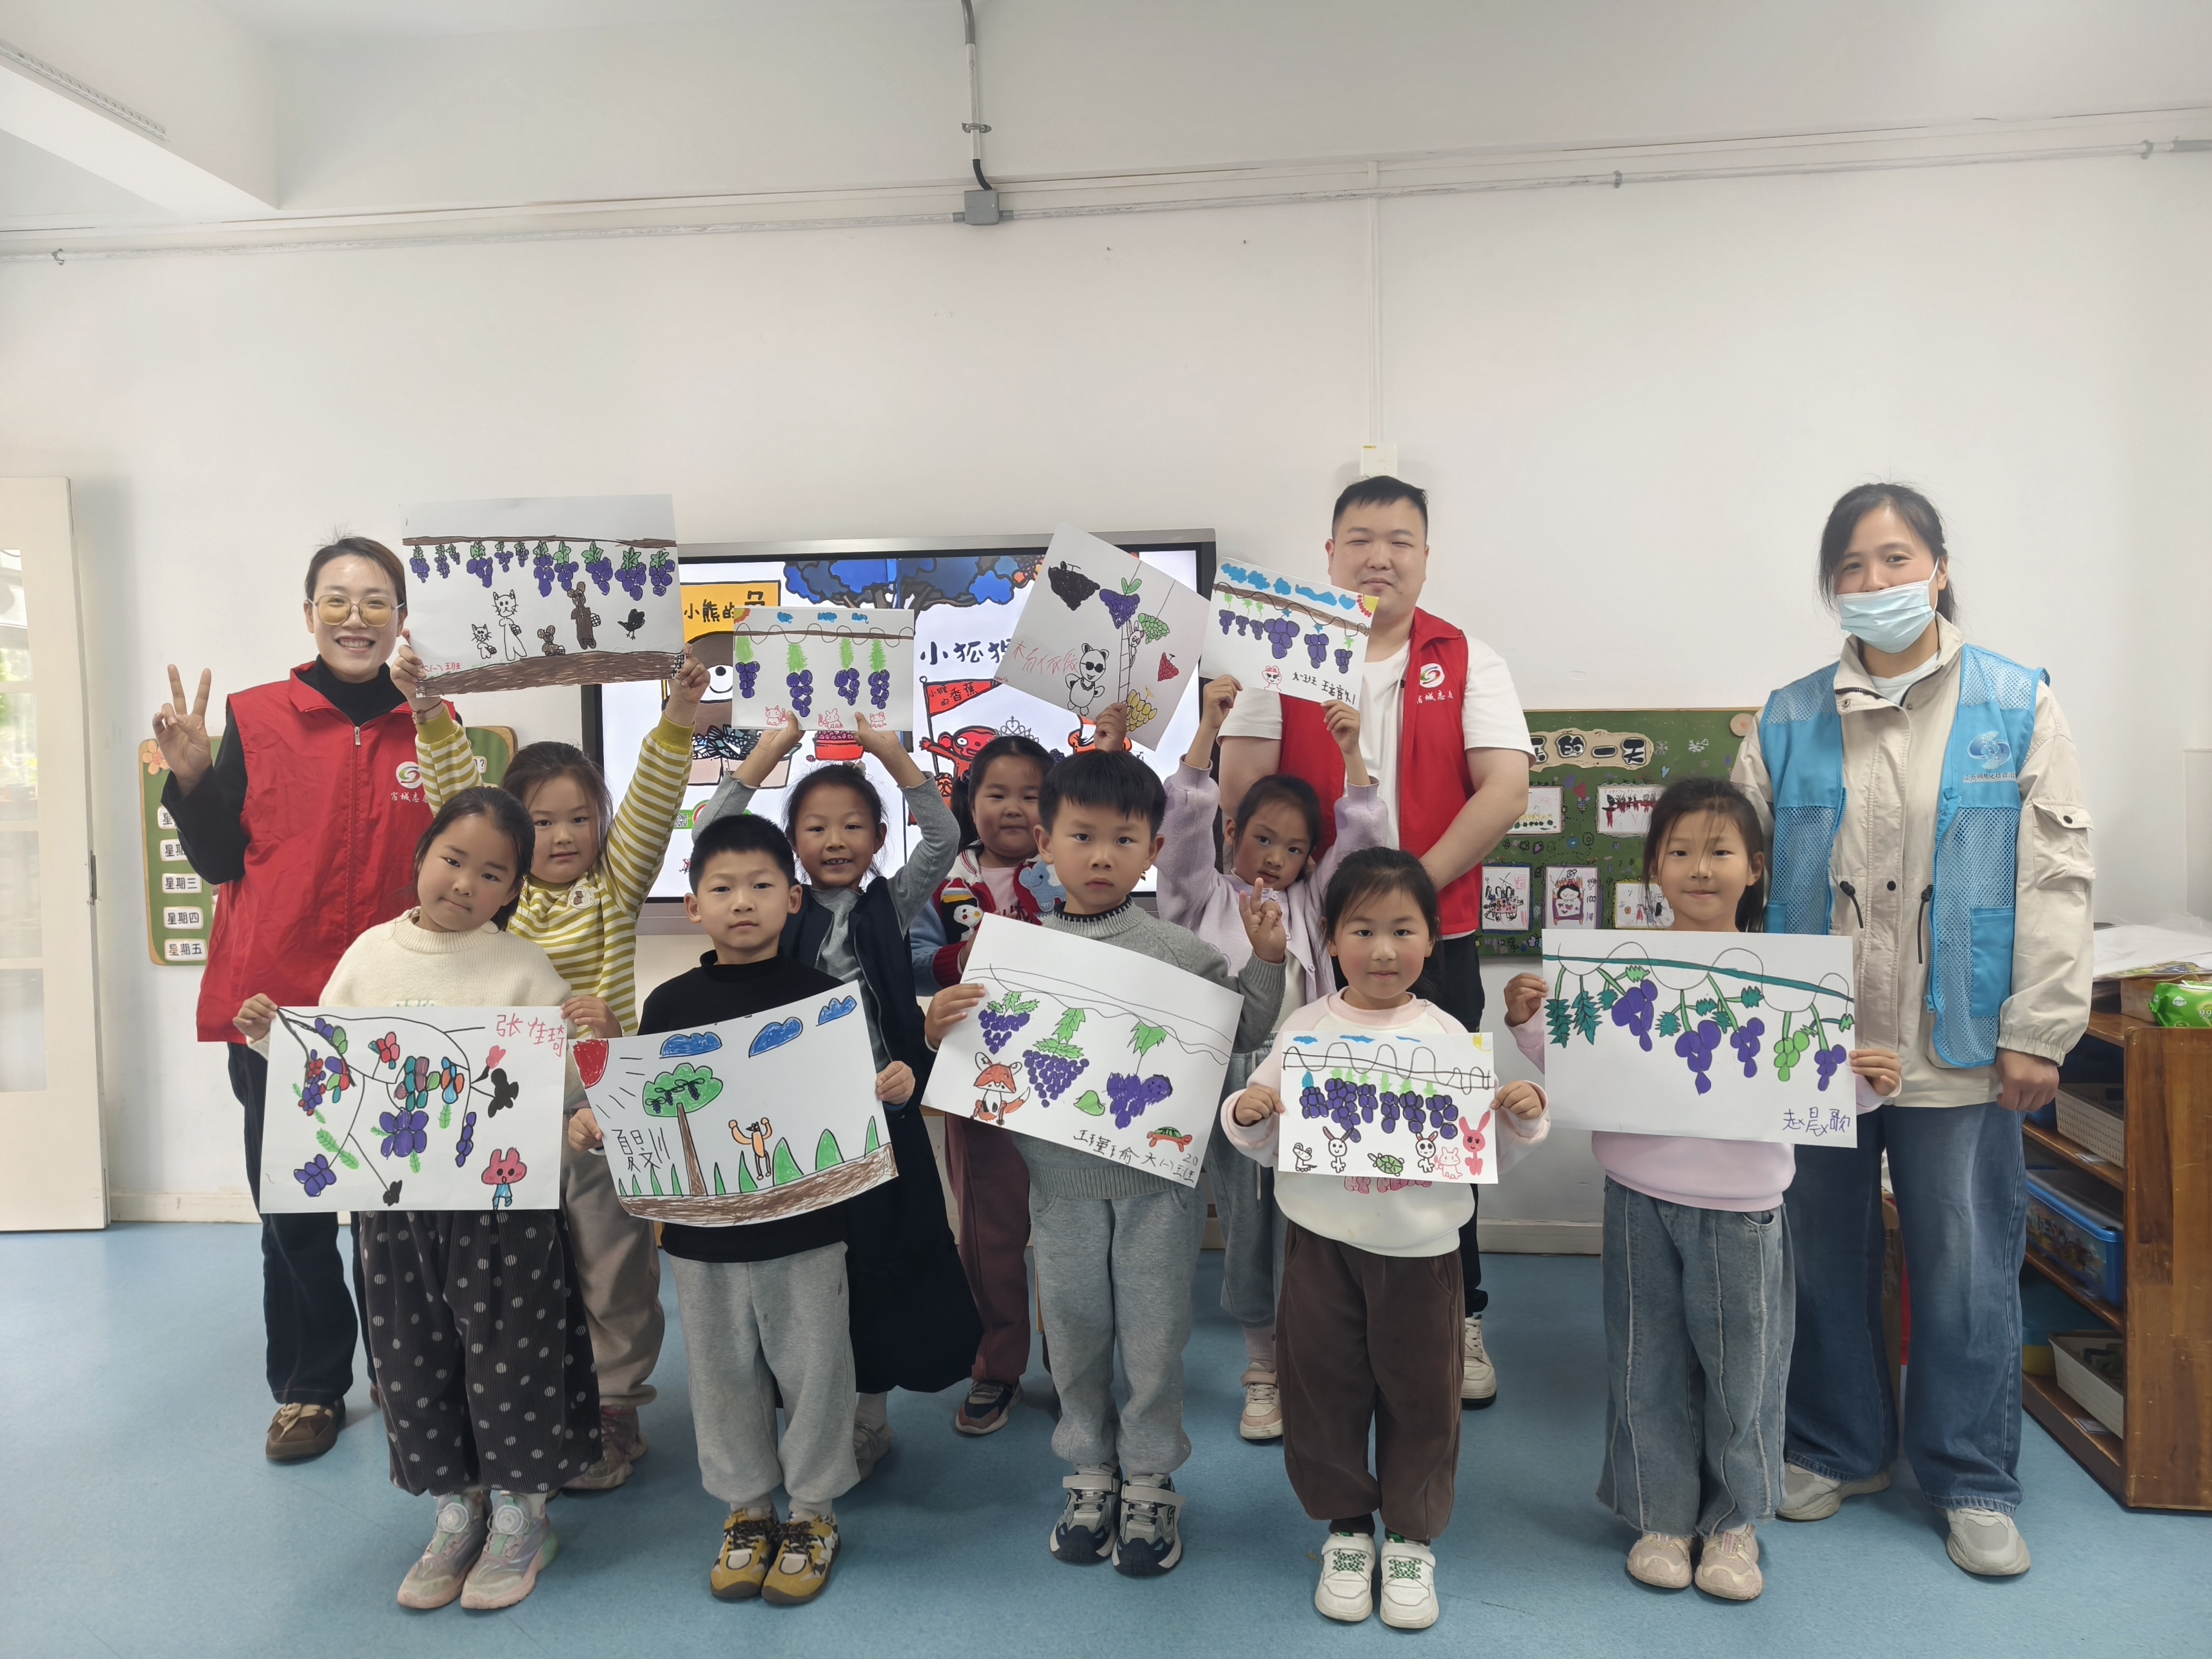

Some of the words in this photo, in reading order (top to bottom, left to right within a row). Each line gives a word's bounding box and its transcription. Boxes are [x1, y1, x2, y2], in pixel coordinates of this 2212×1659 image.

[1964, 772, 2018, 780] 江苏网格化社会治
[165, 877, 198, 889] 星期三
[167, 912, 199, 925] 星期四
[169, 943, 203, 956] 星期五
